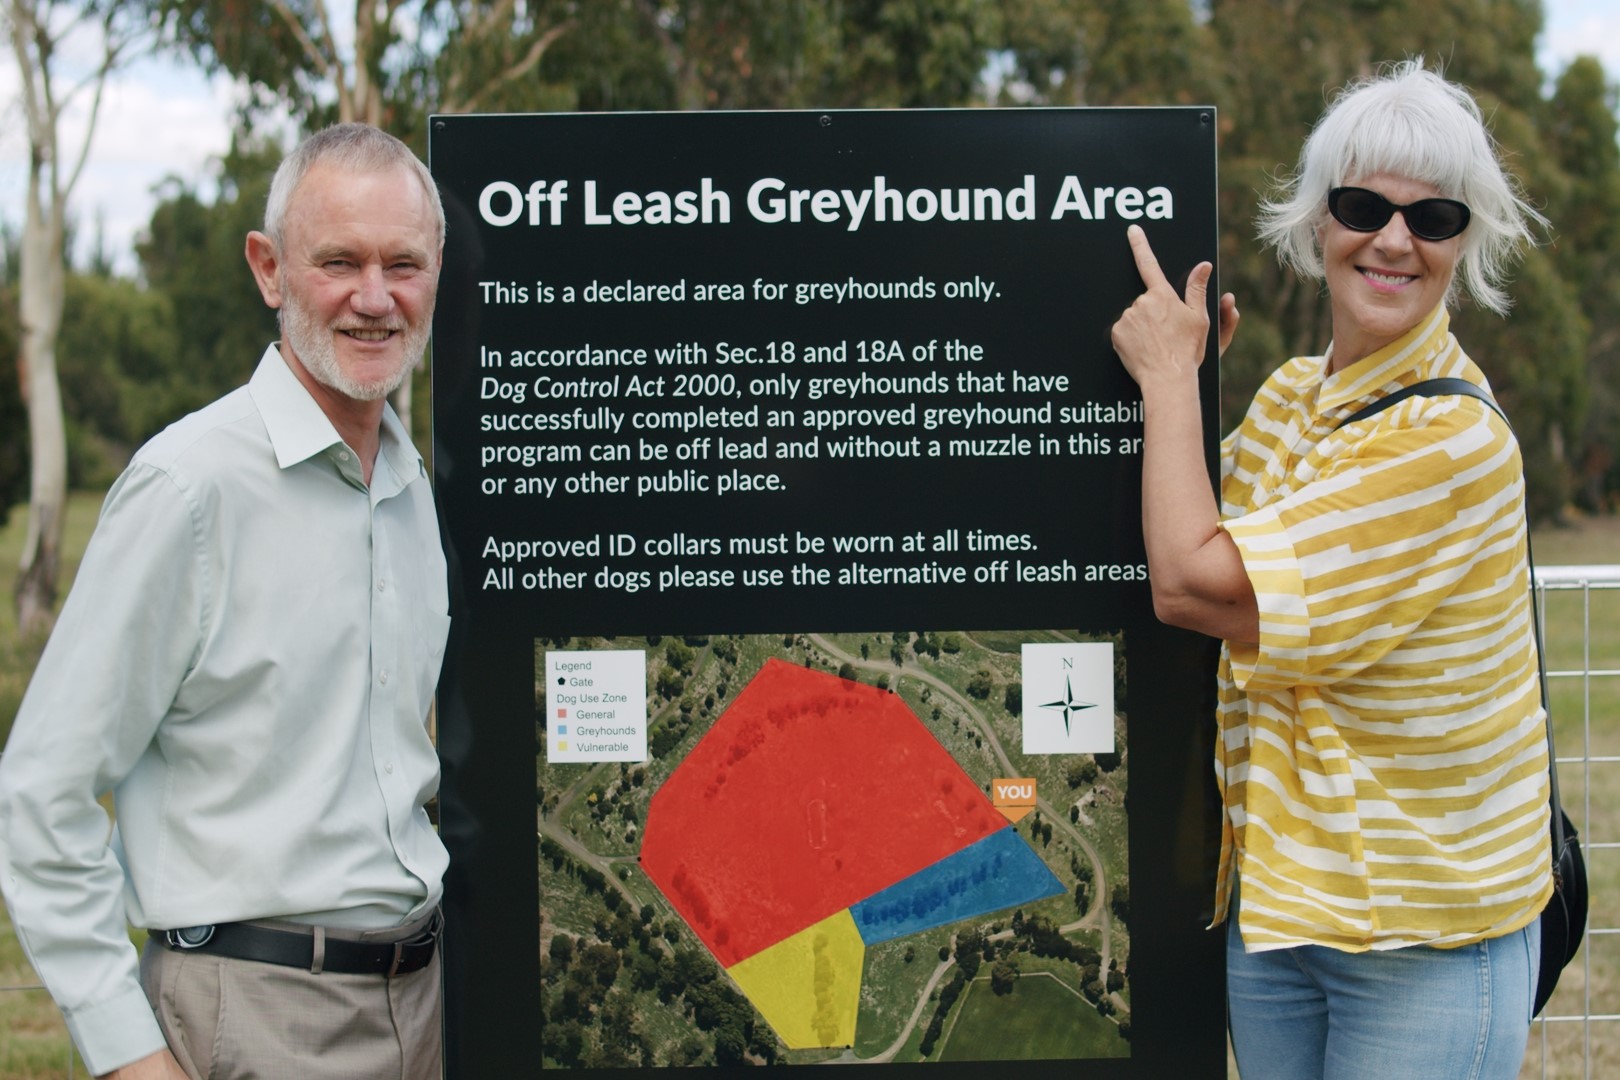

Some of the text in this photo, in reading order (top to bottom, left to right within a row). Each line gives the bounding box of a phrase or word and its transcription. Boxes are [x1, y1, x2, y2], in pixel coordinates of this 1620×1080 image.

[478, 174, 1174, 232] Off Leash Greyhound Area
[478, 275, 1001, 305] This is a declared area for greyhounds only.
[480, 338, 984, 368] In accordance with Sec.18 and 18A of the
[480, 369, 1070, 404] Dog Control Act 2000, only greyhounds that have
[480, 400, 1144, 434] successfully completed an approved greyhound suitabil
[481, 432, 1145, 468] program can be off lead and without a muzzle in this ar
[481, 468, 787, 499] or any other public place.
[481, 528, 1038, 563] Approved ID collars must be worn at all times.
[482, 567, 514, 590] All
[521, 566, 588, 590] other
[594, 565, 651, 593] dogs
[659, 564, 735, 592] please
[742, 569, 784, 587] use
[790, 562, 831, 586] the
[837, 561, 967, 585] alternative
[973, 560, 1009, 583] off
[1016, 559, 1077, 583] leash
[555, 661, 592, 672] Legend
[1063, 657, 1073, 669] N
[569, 677, 594, 687] Gate
[556, 693, 628, 705] Dog Use Zone
[576, 710, 615, 719] General
[576, 726, 636, 737] Greyhounds
[576, 742, 629, 752] Vulnerable
[997, 785, 1032, 799] YOU
